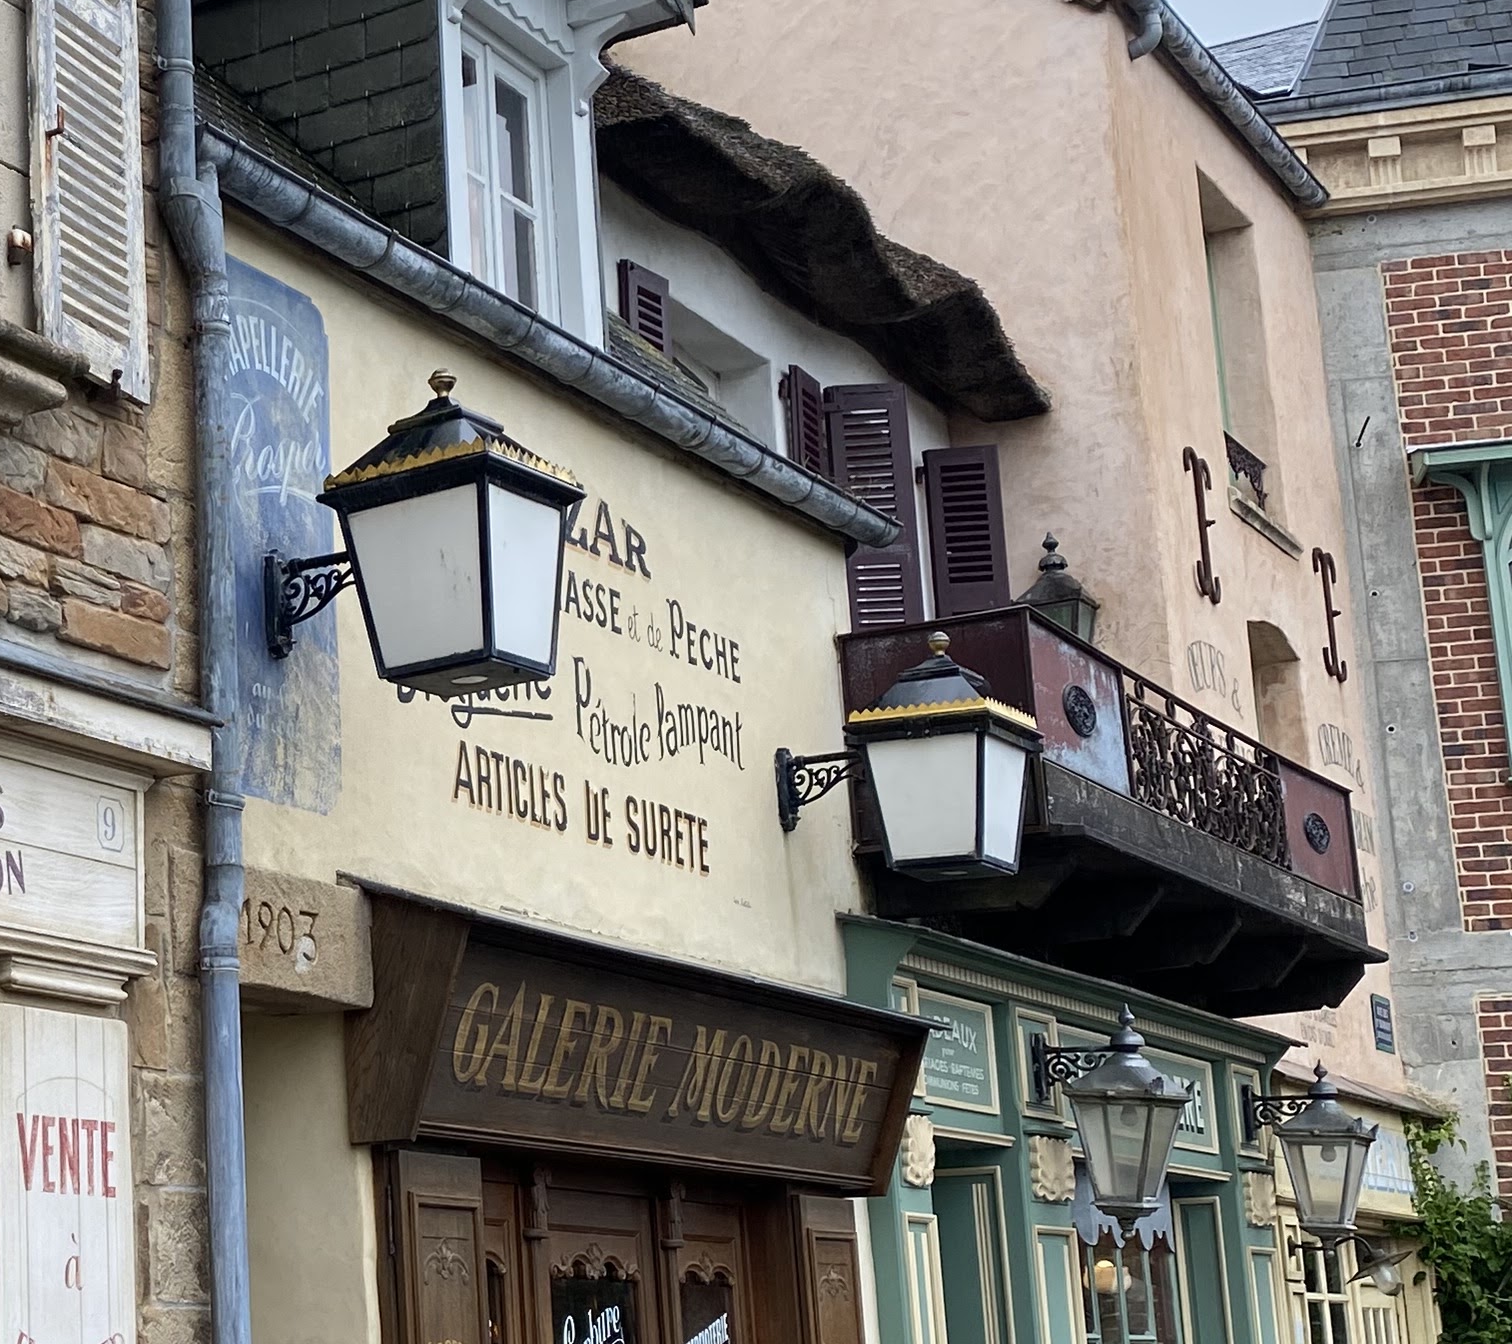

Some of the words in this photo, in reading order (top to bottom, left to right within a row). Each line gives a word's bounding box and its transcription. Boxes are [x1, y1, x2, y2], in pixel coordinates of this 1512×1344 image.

[562, 570, 623, 635] ASSE
[628, 605, 641, 643] et
[648, 623, 664, 653] de
[666, 598, 742, 684] PECHE
[573, 656, 651, 768] Pétrole
[655, 682, 746, 771] lampant
[103, 809, 116, 842] 9
[453, 740, 568, 833] ARTICLES
[585, 778, 614, 847] DE
[625, 794, 711, 875] SURETE
[242, 897, 319, 962] 1903
[452, 981, 674, 1116] GALERIE
[669, 1024, 880, 1146] MODERNE
[929, 1016, 978, 1054] DEAUX
[16, 1113, 117, 1198] VENTE
